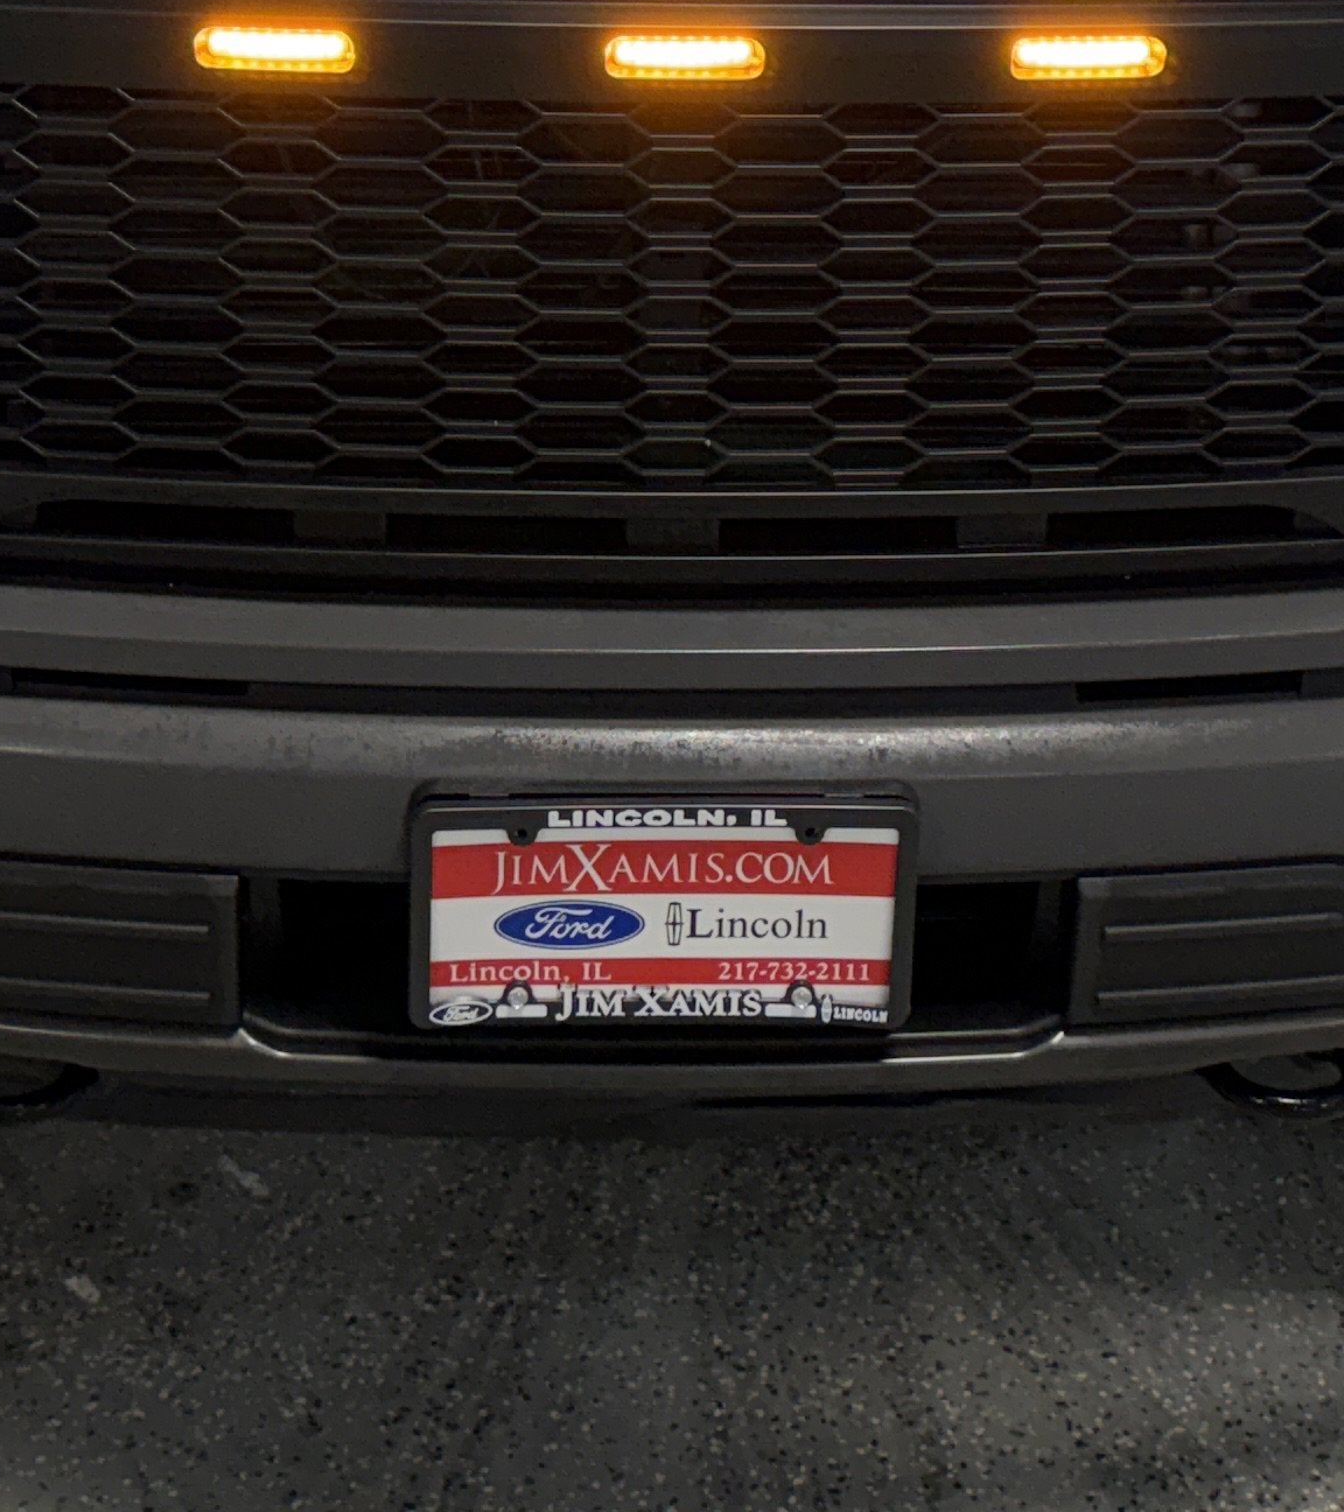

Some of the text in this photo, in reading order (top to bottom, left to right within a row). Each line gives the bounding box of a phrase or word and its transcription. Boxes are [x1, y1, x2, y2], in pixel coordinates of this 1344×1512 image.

[547, 809, 788, 827] LINCOLN, IL
[492, 844, 834, 893] JIMXAMIS.COM
[525, 907, 613, 939] Ford
[686, 908, 828, 939] Lincoln
[582, 962, 612, 981] IL
[718, 962, 870, 981] 217-732-2111
[555, 982, 762, 1021] JIM XAMIS
[834, 1009, 888, 1023] LINCOLN
